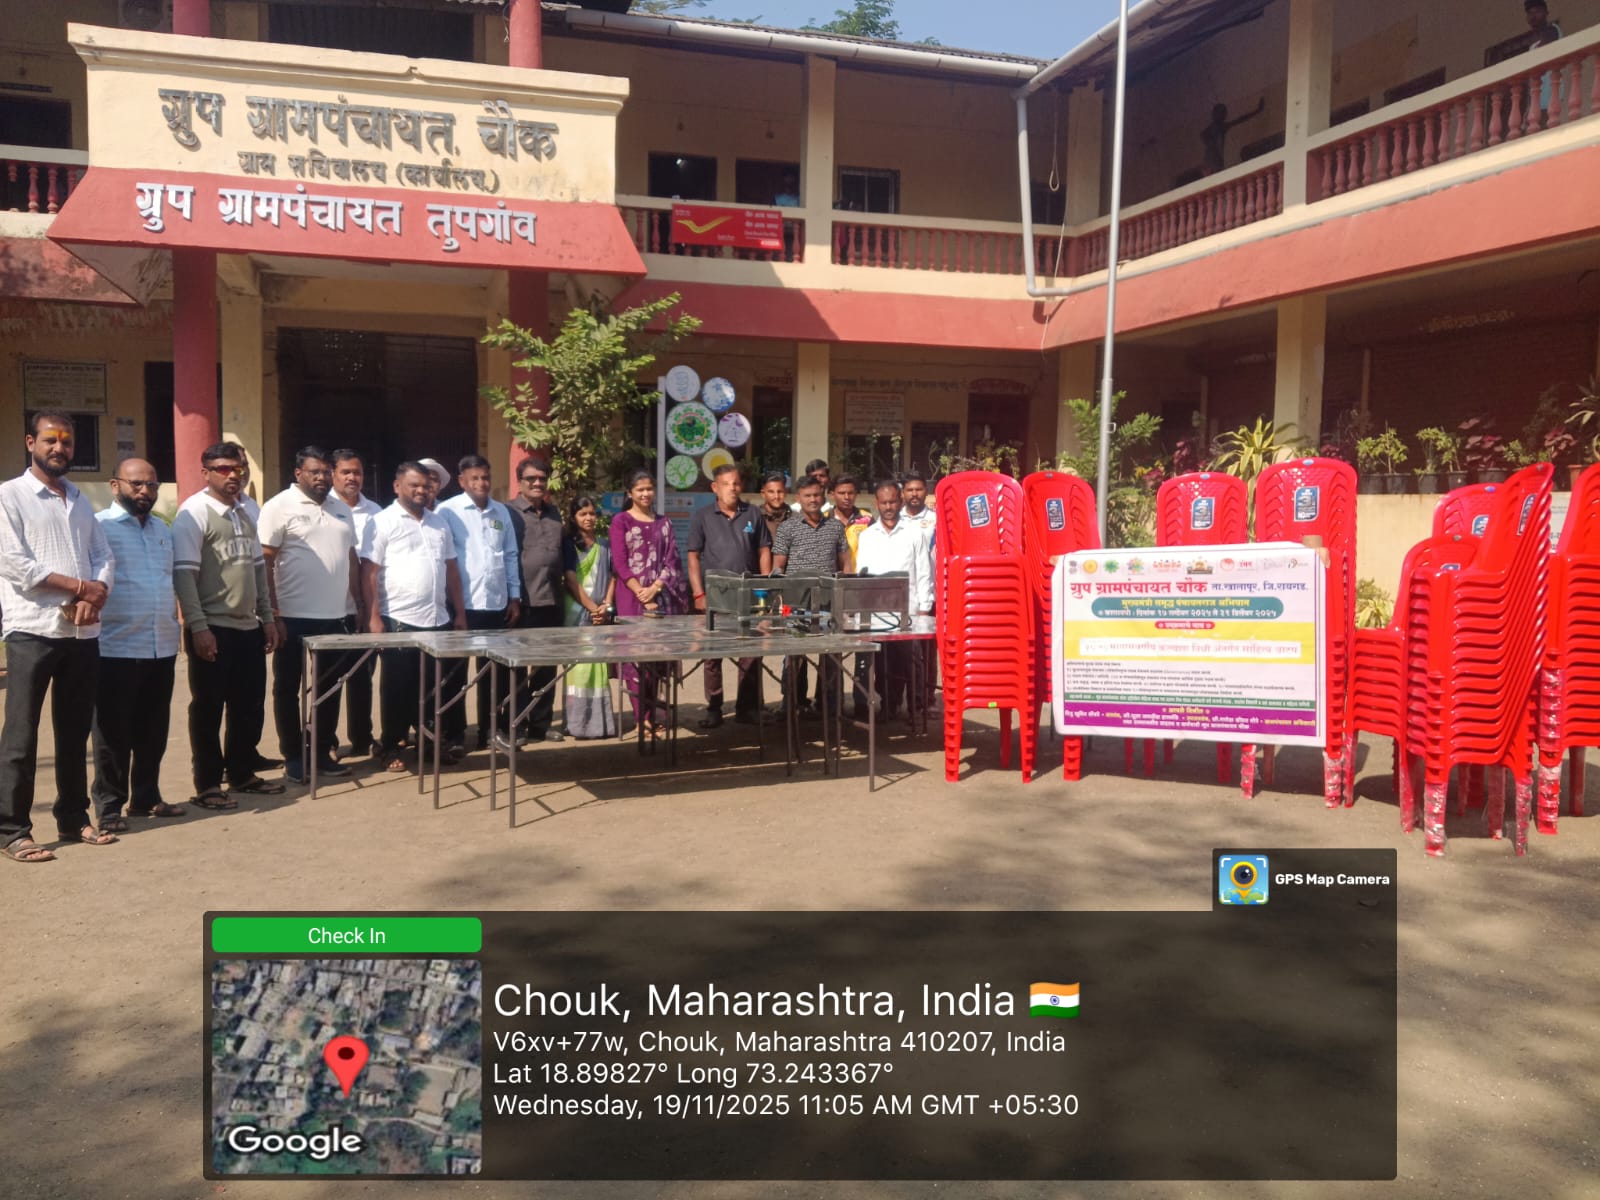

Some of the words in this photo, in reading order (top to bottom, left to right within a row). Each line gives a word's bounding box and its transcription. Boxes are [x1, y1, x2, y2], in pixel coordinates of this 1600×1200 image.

[158, 88, 224, 150] ग्रुप
[477, 100, 558, 161] चौक
[237, 152, 275, 175] ग्राम
[288, 149, 386, 183] सचिवालय
[136, 182, 193, 231] ग्रुप
[218, 184, 402, 234] ग्रामपंचायत
[426, 201, 536, 250] तुपगांव
[1070, 582, 1091, 599] ग्रुप
[1096, 578, 1171, 595] ग्रामपंचायत
[1176, 577, 1207, 593] चौक
